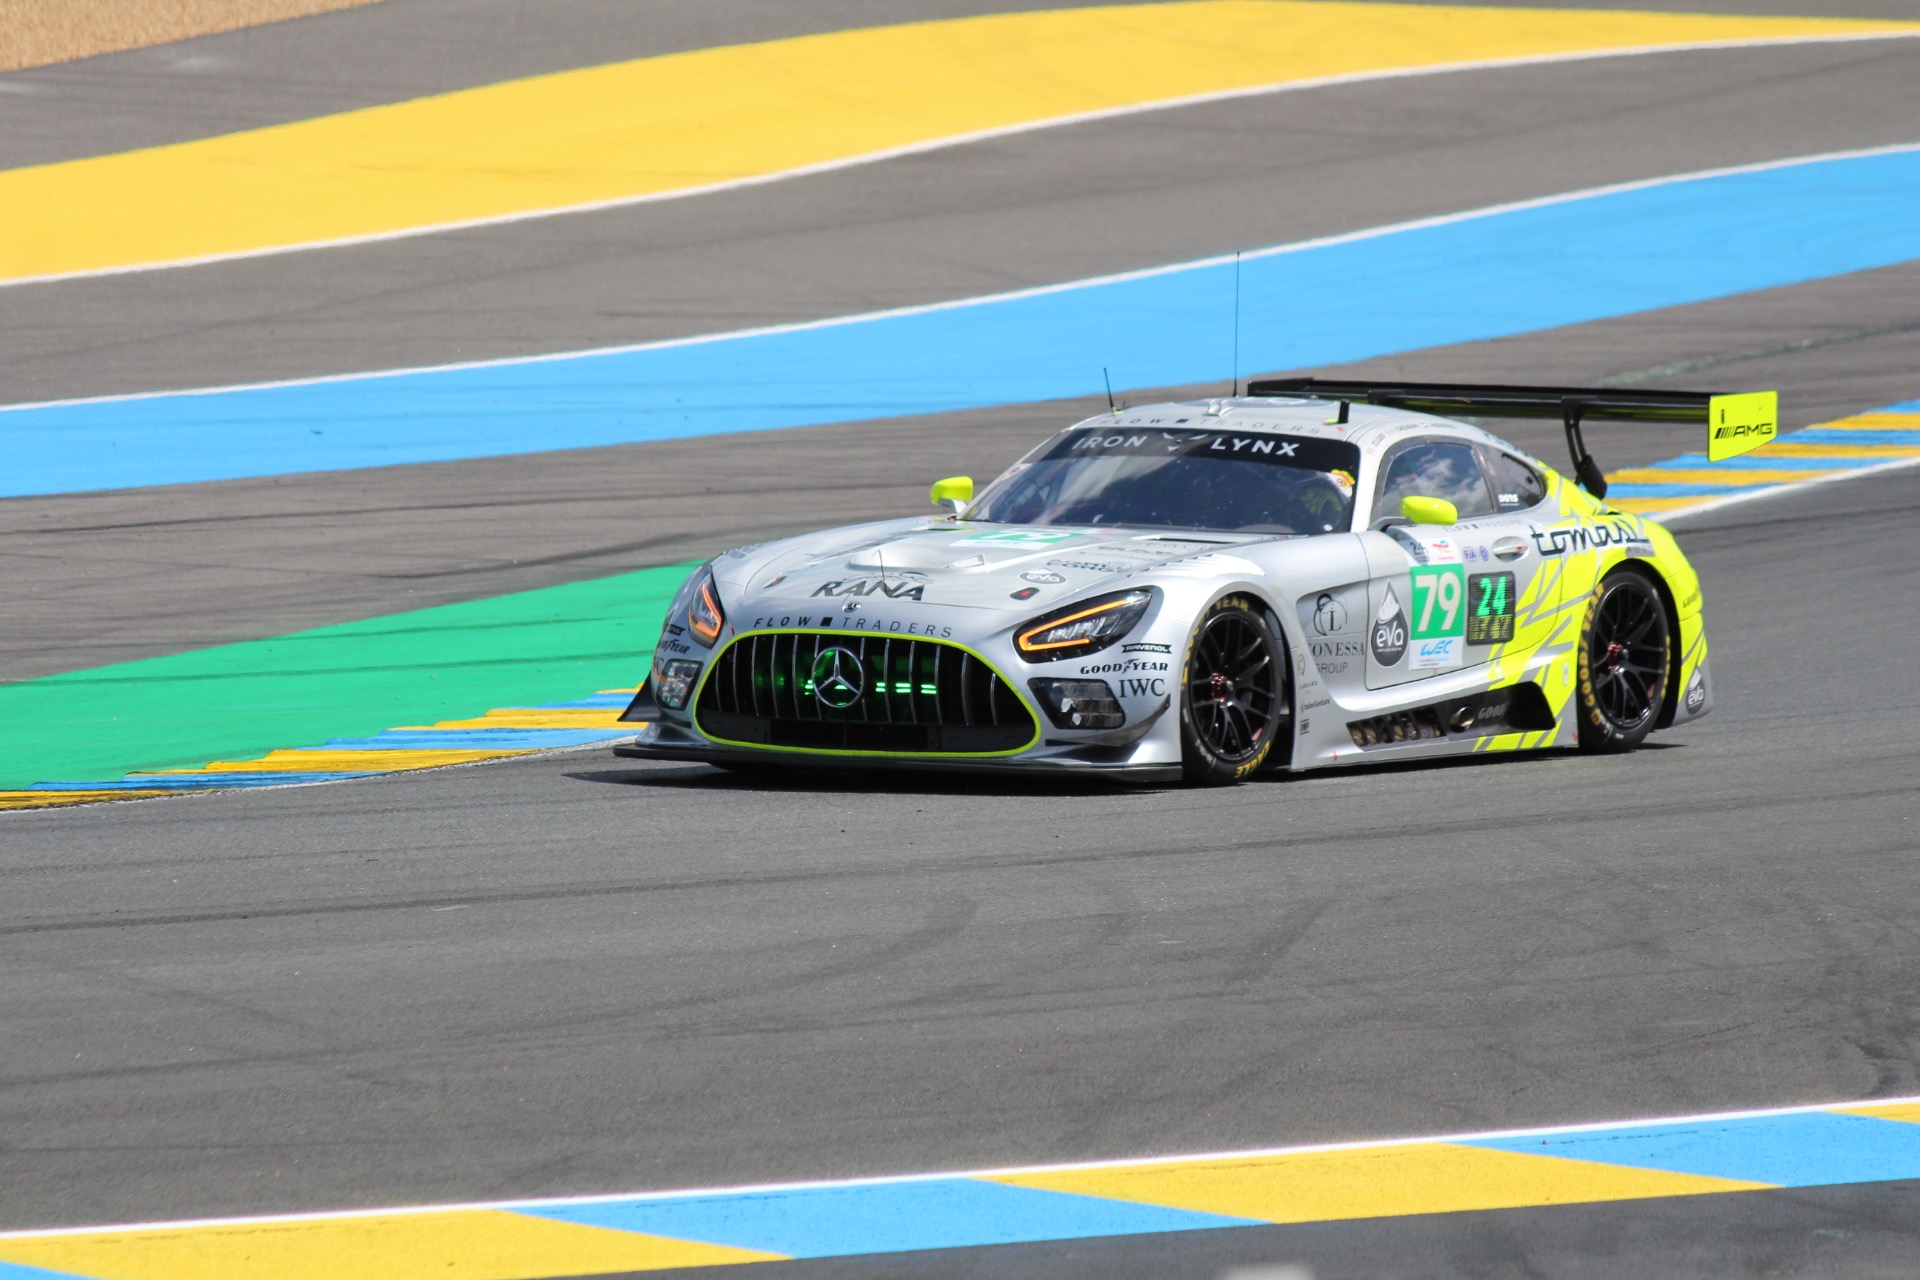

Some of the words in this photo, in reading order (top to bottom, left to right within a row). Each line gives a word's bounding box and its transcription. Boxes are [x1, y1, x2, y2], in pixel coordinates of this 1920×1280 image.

[1200, 418, 1321, 434] TRADERS
[1733, 423, 1773, 438] AMG
[1071, 434, 1149, 450] IRON
[1210, 437, 1300, 457] LYNX
[809, 580, 926, 602] RANA
[1415, 571, 1462, 633] 79
[1475, 576, 1507, 617] 24
[753, 616, 812, 629] FLOW
[842, 617, 952, 638] TRADERS
[1420, 640, 1454, 656] WEC
[1080, 659, 1169, 674] GOODYEAR
[1119, 678, 1165, 698] IWC
[1233, 740, 1271, 779] EAGLE
